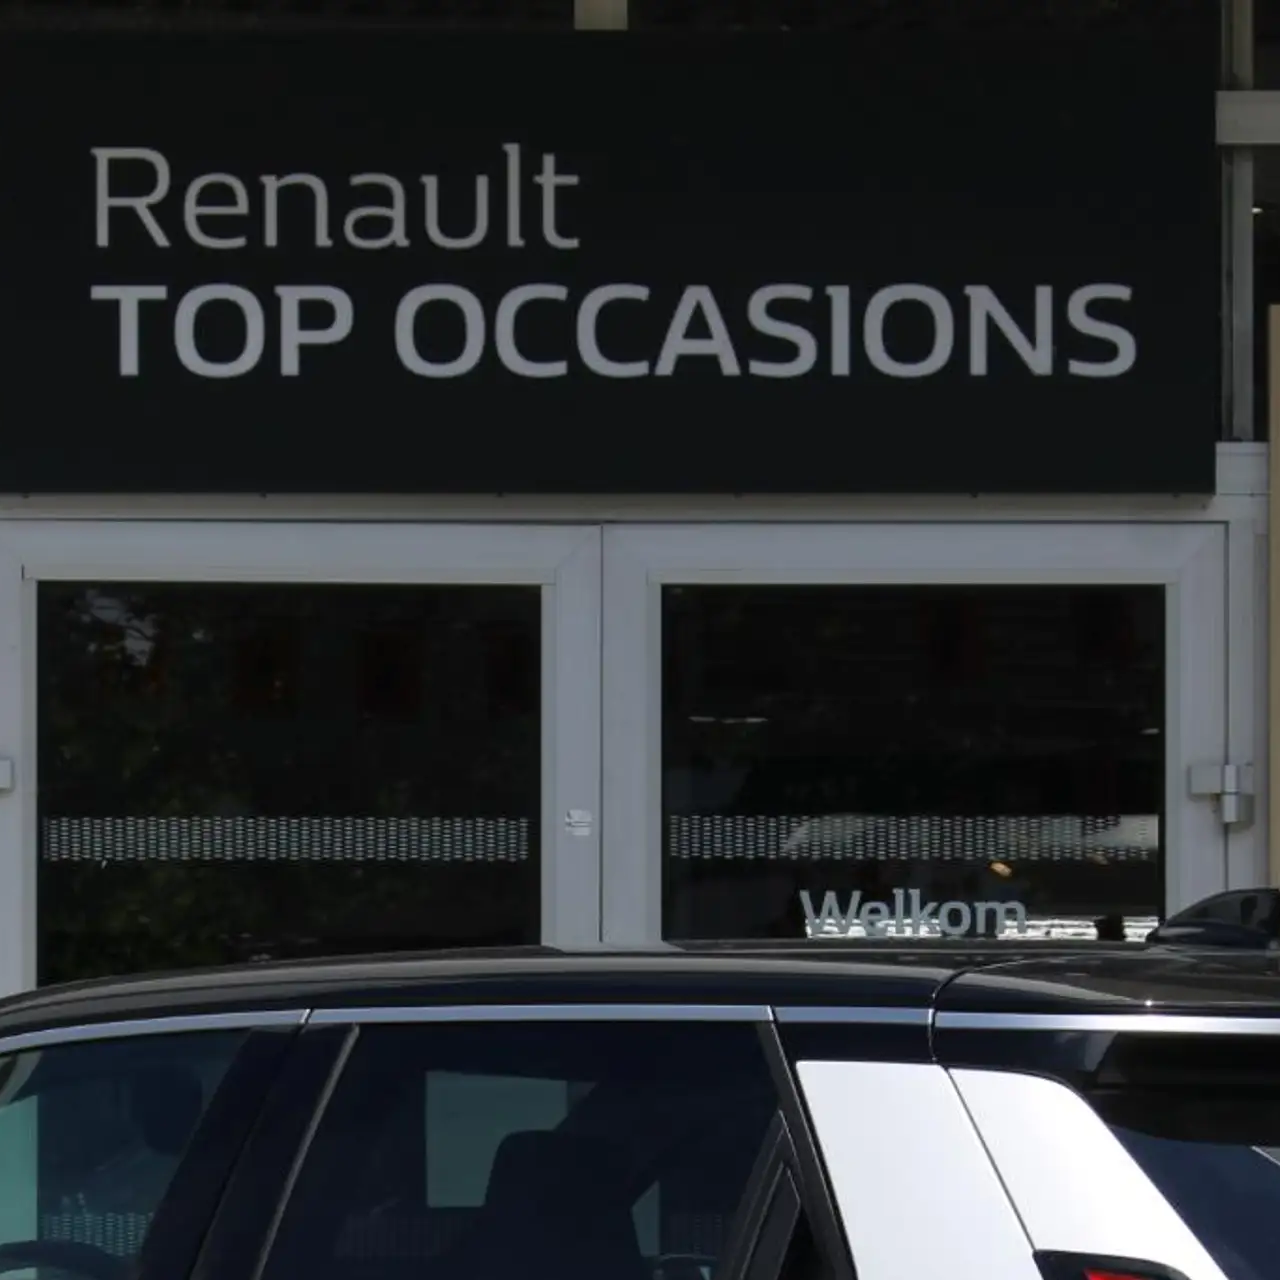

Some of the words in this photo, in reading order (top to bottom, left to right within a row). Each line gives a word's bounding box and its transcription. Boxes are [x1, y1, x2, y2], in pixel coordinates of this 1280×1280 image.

[91, 143, 580, 250] Renault
[91, 284, 354, 379] TOP
[395, 284, 1137, 379] OCCASIONS
[799, 888, 1027, 936] Welkom
